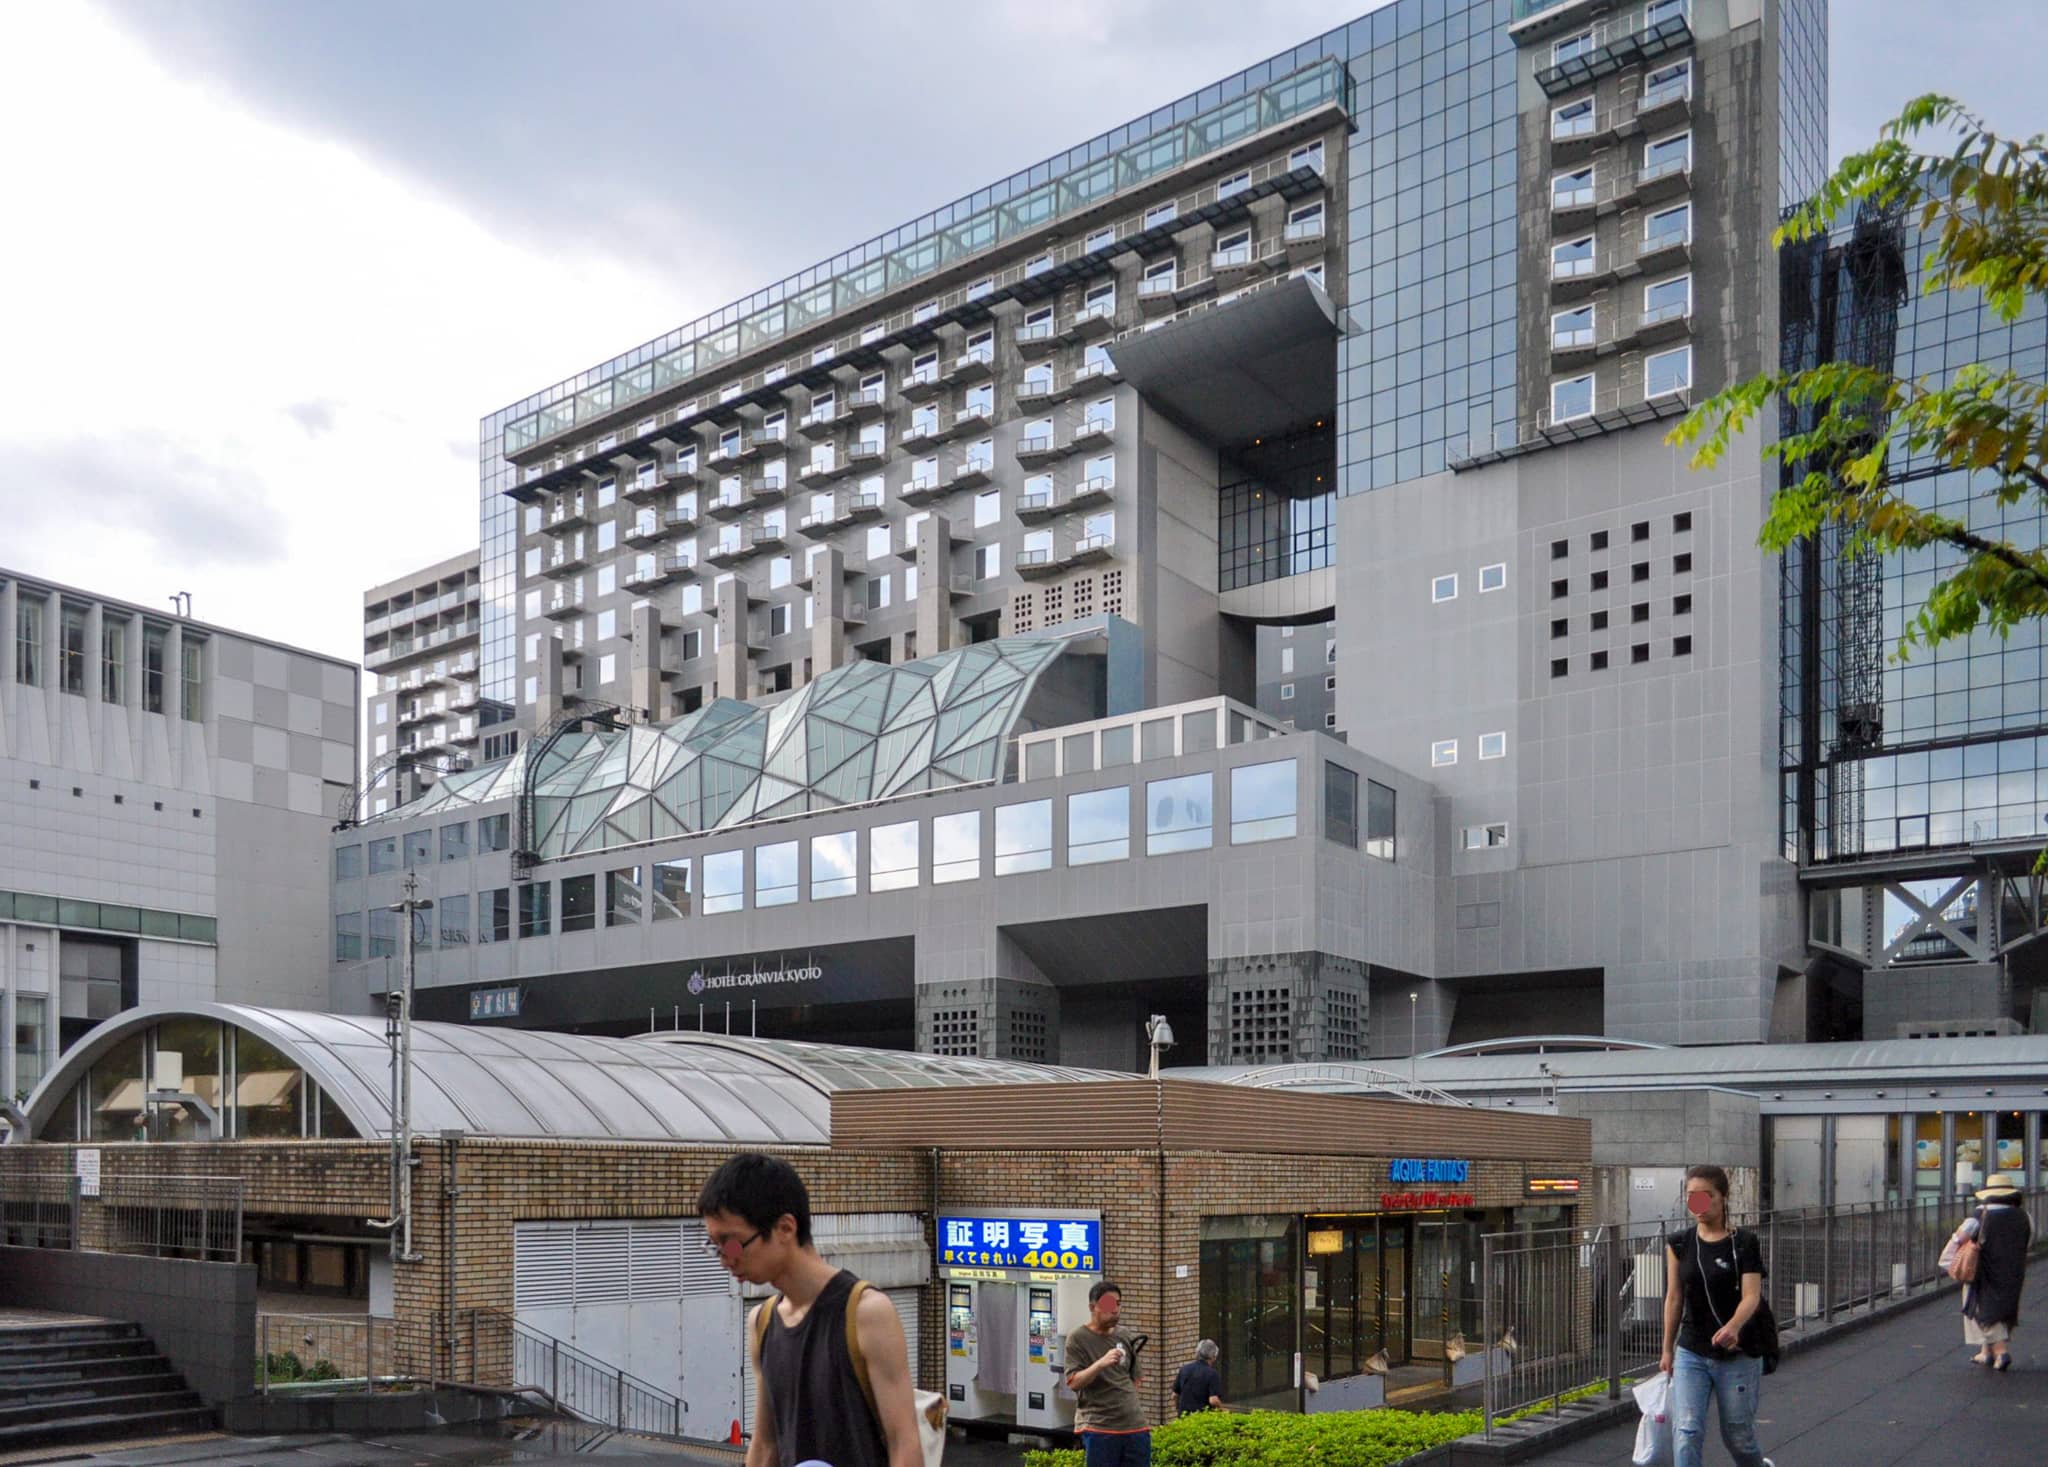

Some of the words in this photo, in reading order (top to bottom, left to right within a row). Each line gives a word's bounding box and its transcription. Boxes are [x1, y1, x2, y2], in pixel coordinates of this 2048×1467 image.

[706, 975, 736, 989] HOTEL
[738, 970, 785, 987] GRANVIA
[786, 966, 822, 983] KYOTO
[1391, 1158, 1423, 1182] AQUA
[1426, 1159, 1470, 1183] FANTASY
[946, 1220, 1089, 1251] 証明写真
[944, 1250, 1017, 1265] 早くてきれい
